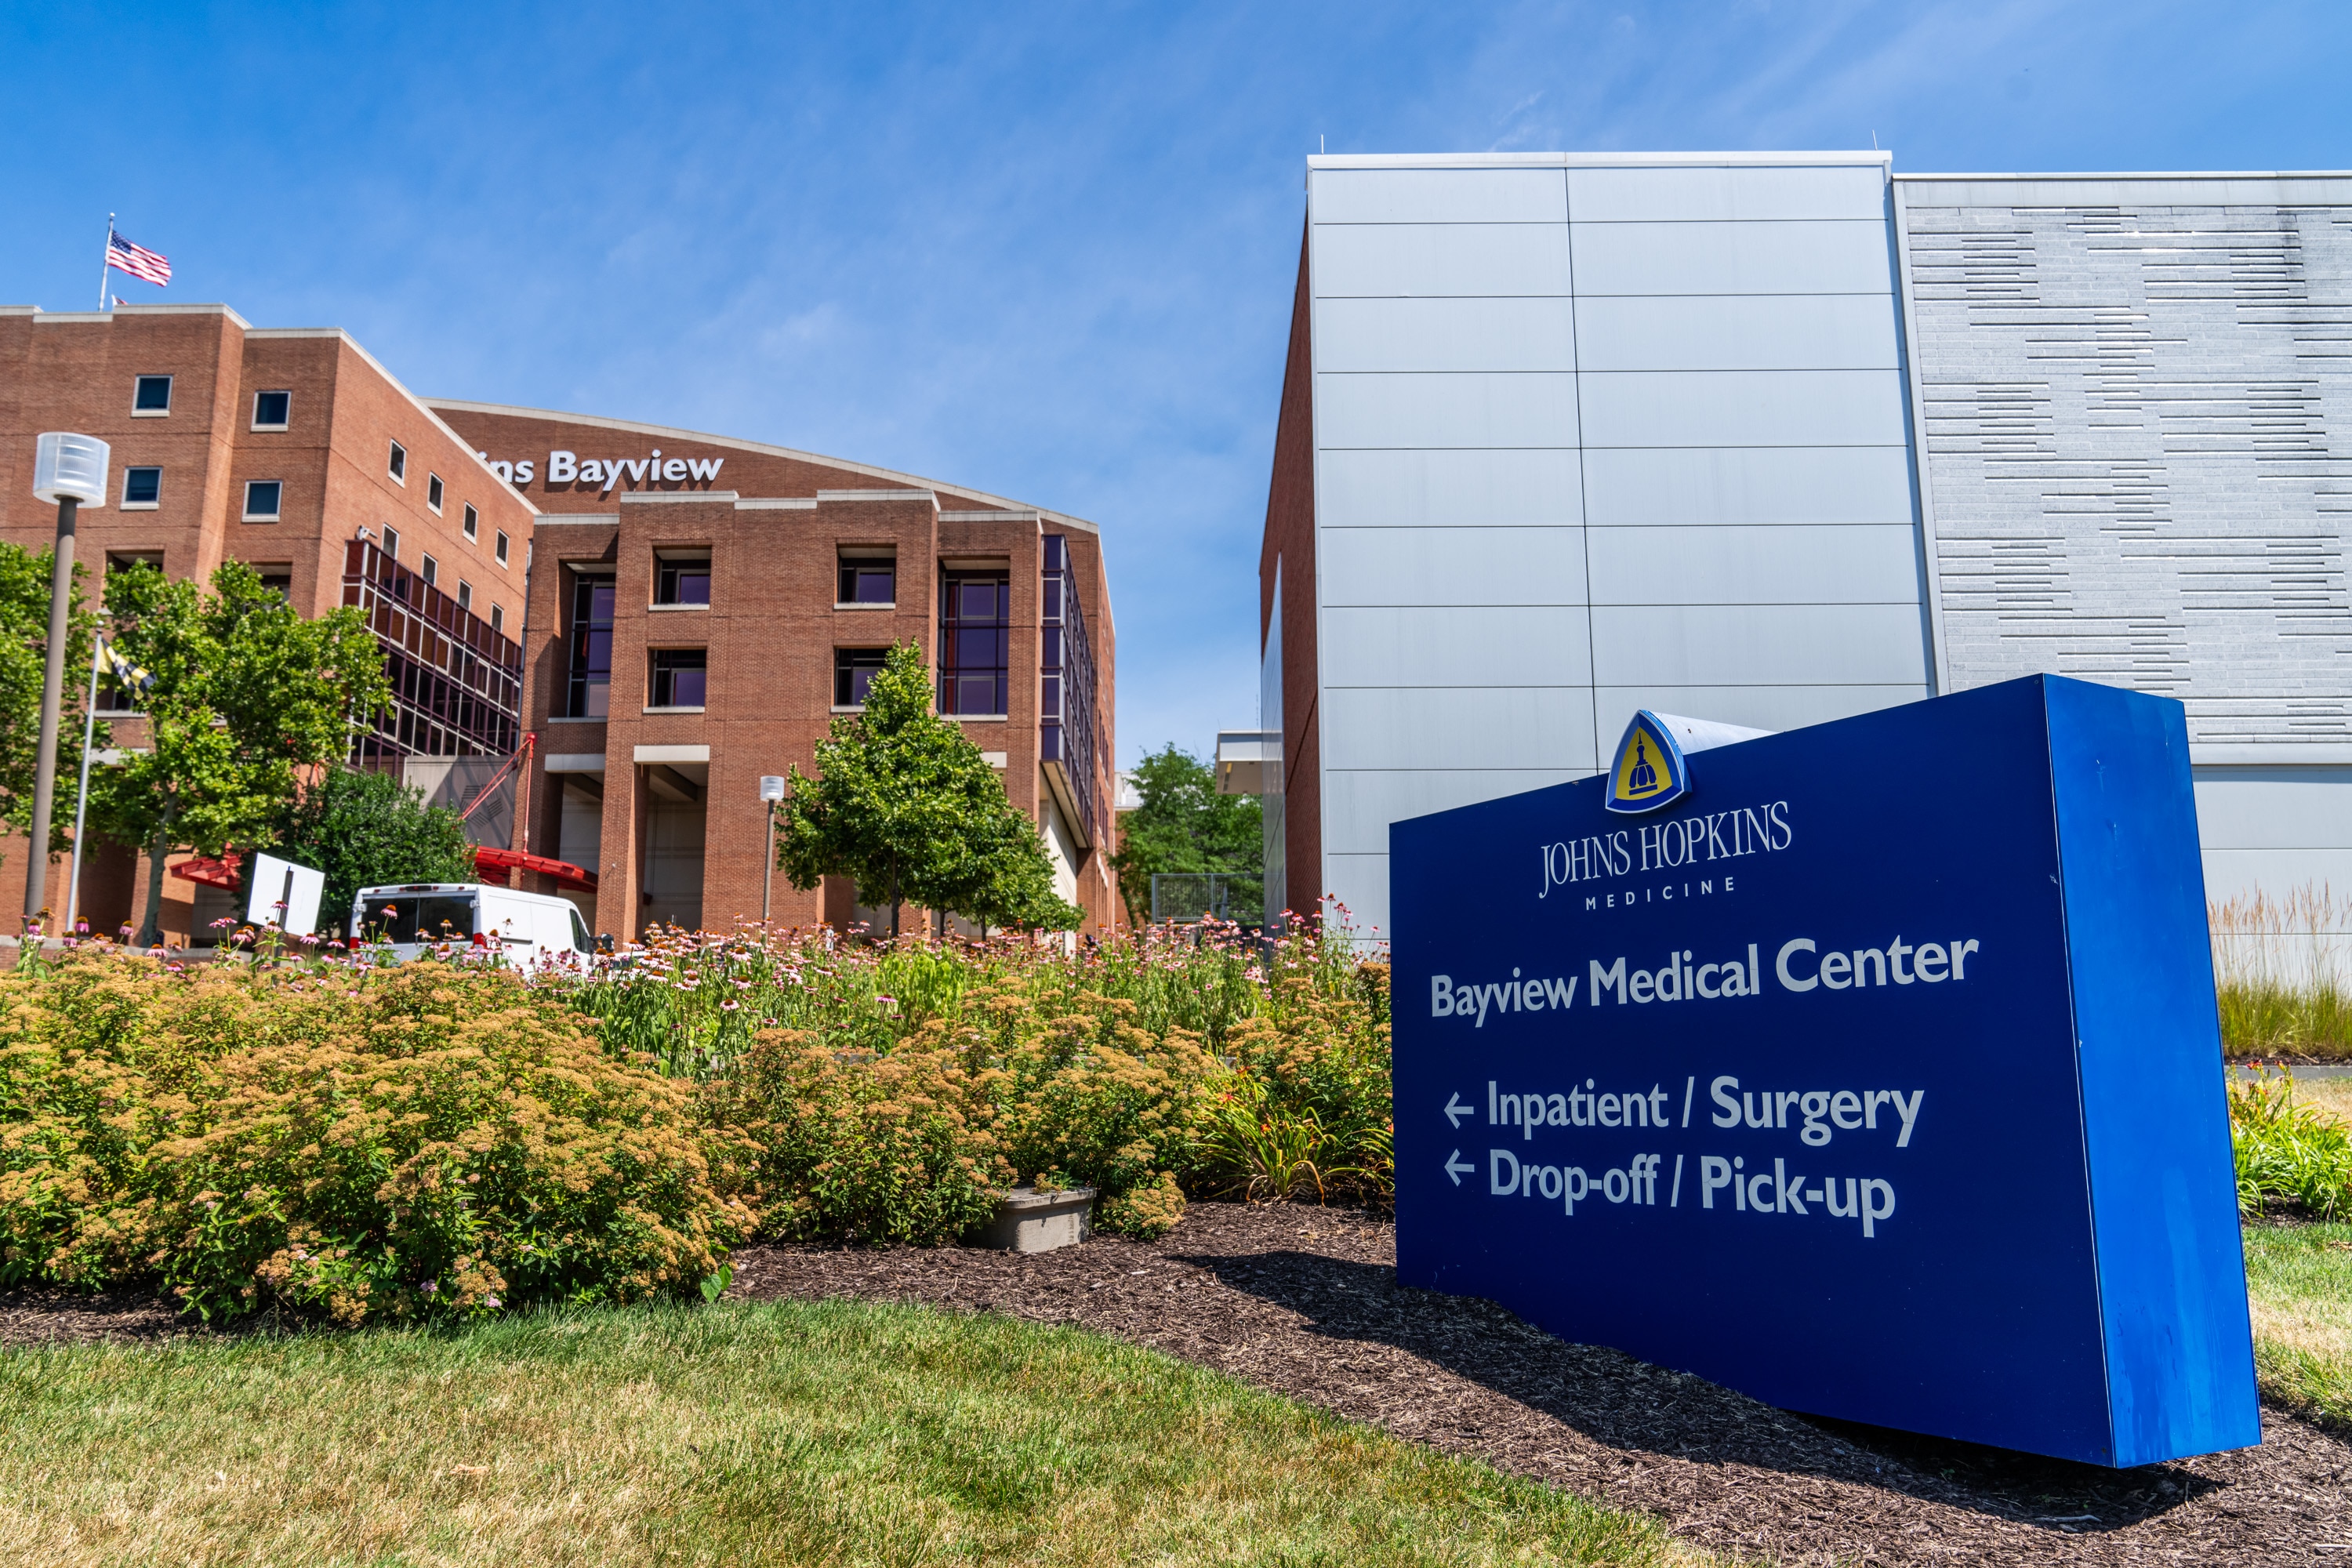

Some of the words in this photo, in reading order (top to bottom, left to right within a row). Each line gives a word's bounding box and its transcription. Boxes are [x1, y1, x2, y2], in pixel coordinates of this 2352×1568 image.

[548, 449, 724, 492] Bayview
[1539, 831, 1632, 898] JOHNS
[1639, 801, 1792, 870] HOPKINS
[1585, 877, 1735, 910] MEDICINE
[1432, 967, 1578, 1028] Bayview
[1589, 944, 1760, 1007] Medical
[1776, 935, 1980, 992] Center
[1489, 1079, 1669, 1140] Inpatient
[1682, 1076, 1695, 1127] /
[1710, 1076, 1925, 1147] Surgery
[1490, 1149, 1661, 1216] Drop-off
[1671, 1155, 1683, 1207] /
[1700, 1156, 1896, 1238] Pick-up
